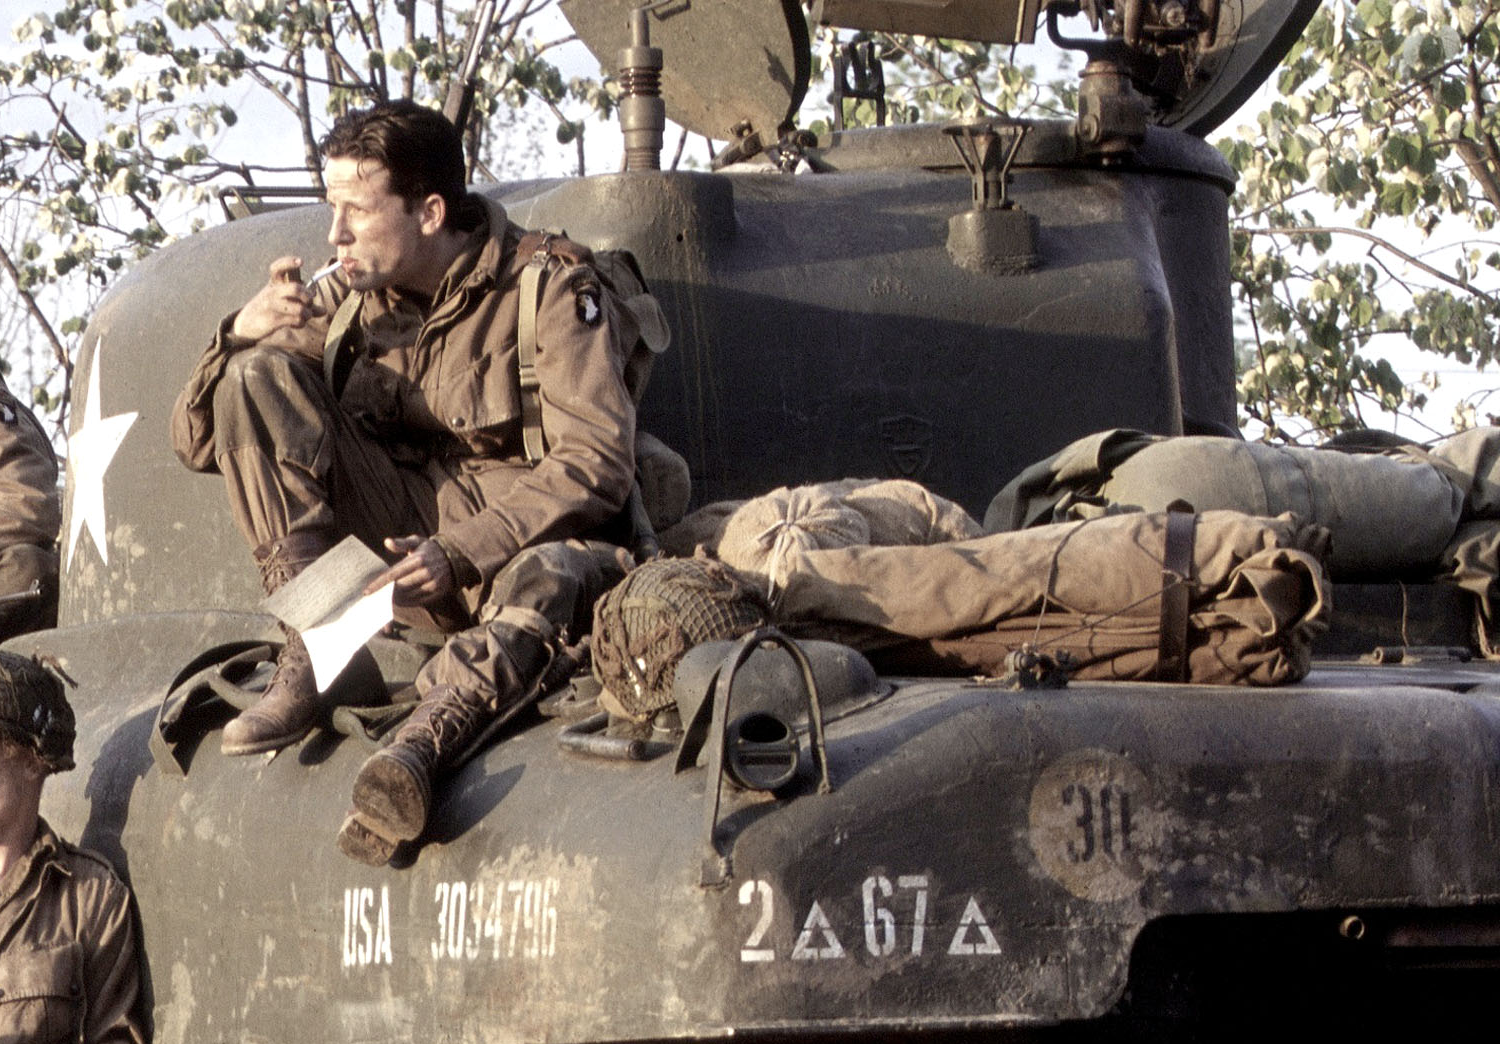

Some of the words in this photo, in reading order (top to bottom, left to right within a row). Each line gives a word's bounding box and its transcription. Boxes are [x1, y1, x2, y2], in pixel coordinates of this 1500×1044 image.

[343, 885, 393, 966] USA
[431, 877, 560, 960] 3034796
[738, 879, 776, 962] 2
[862, 875, 929, 957] 67
